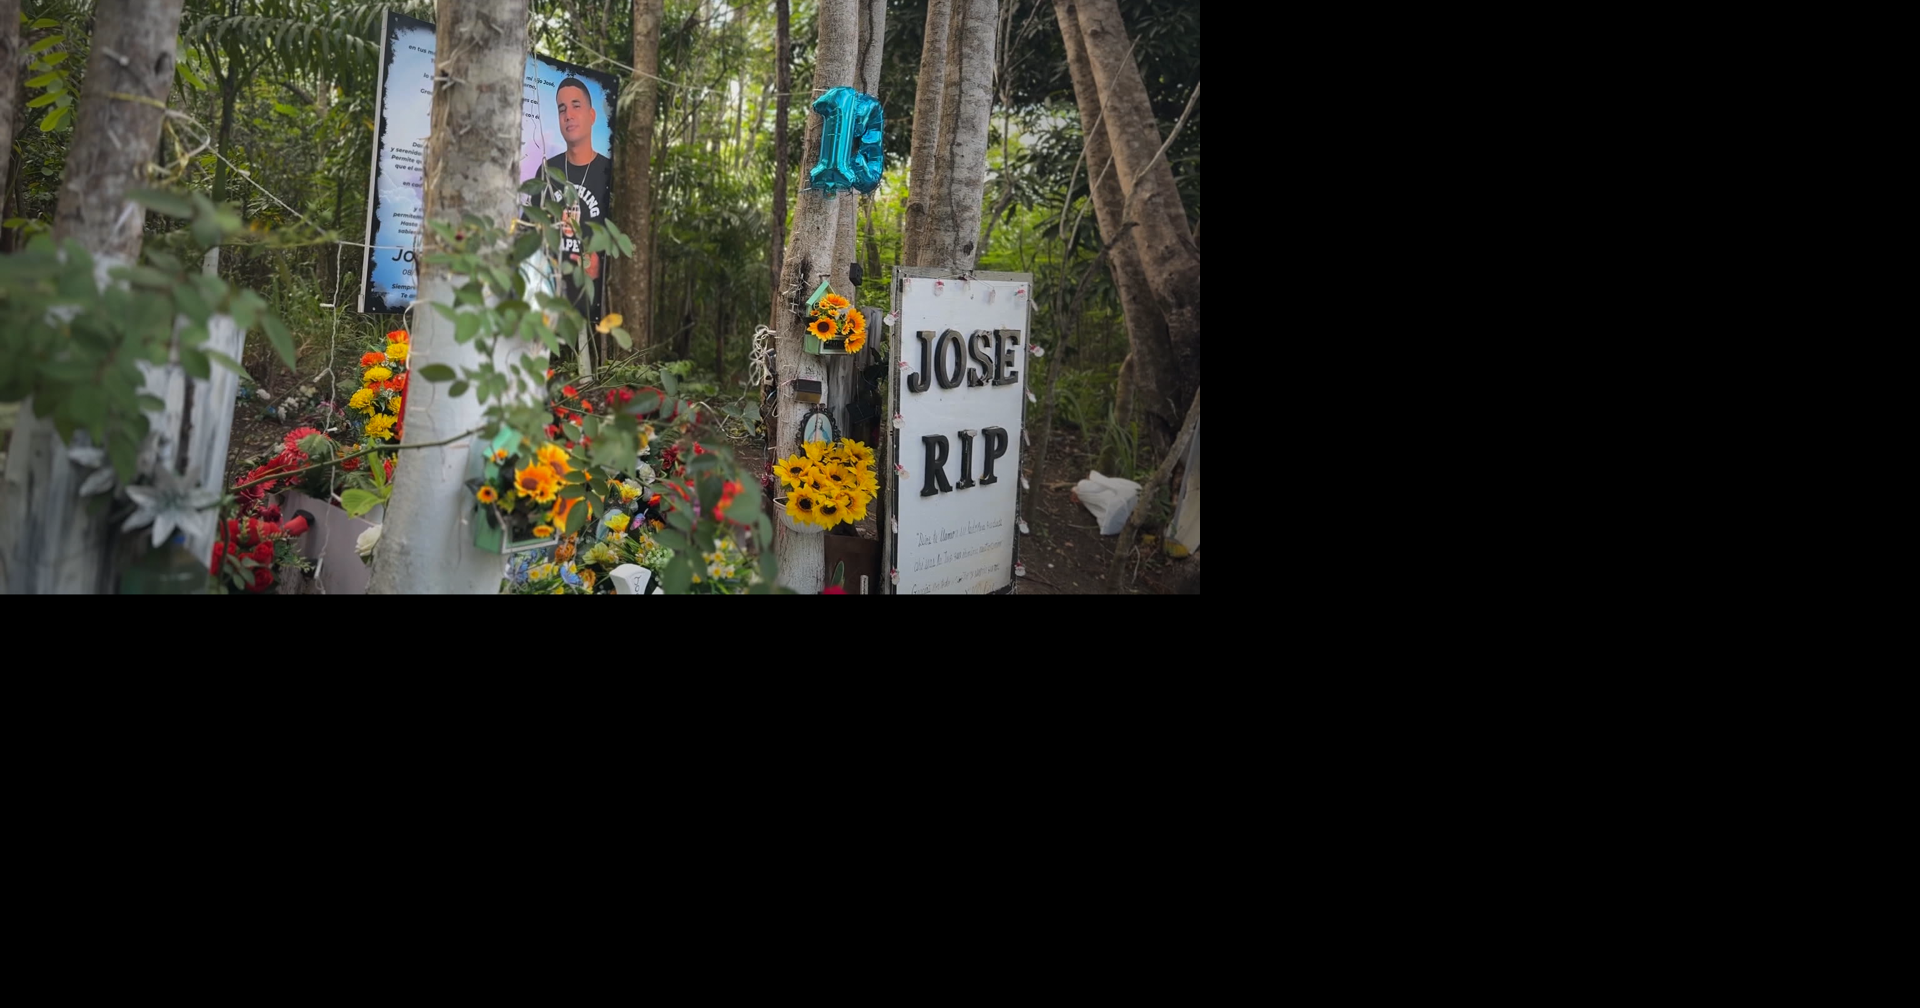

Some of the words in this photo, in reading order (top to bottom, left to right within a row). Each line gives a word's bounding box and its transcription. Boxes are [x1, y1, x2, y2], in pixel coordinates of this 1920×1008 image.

[391, 154, 415, 163] Permite
[907, 328, 1021, 394] JOSE
[920, 426, 1008, 498] RIP
